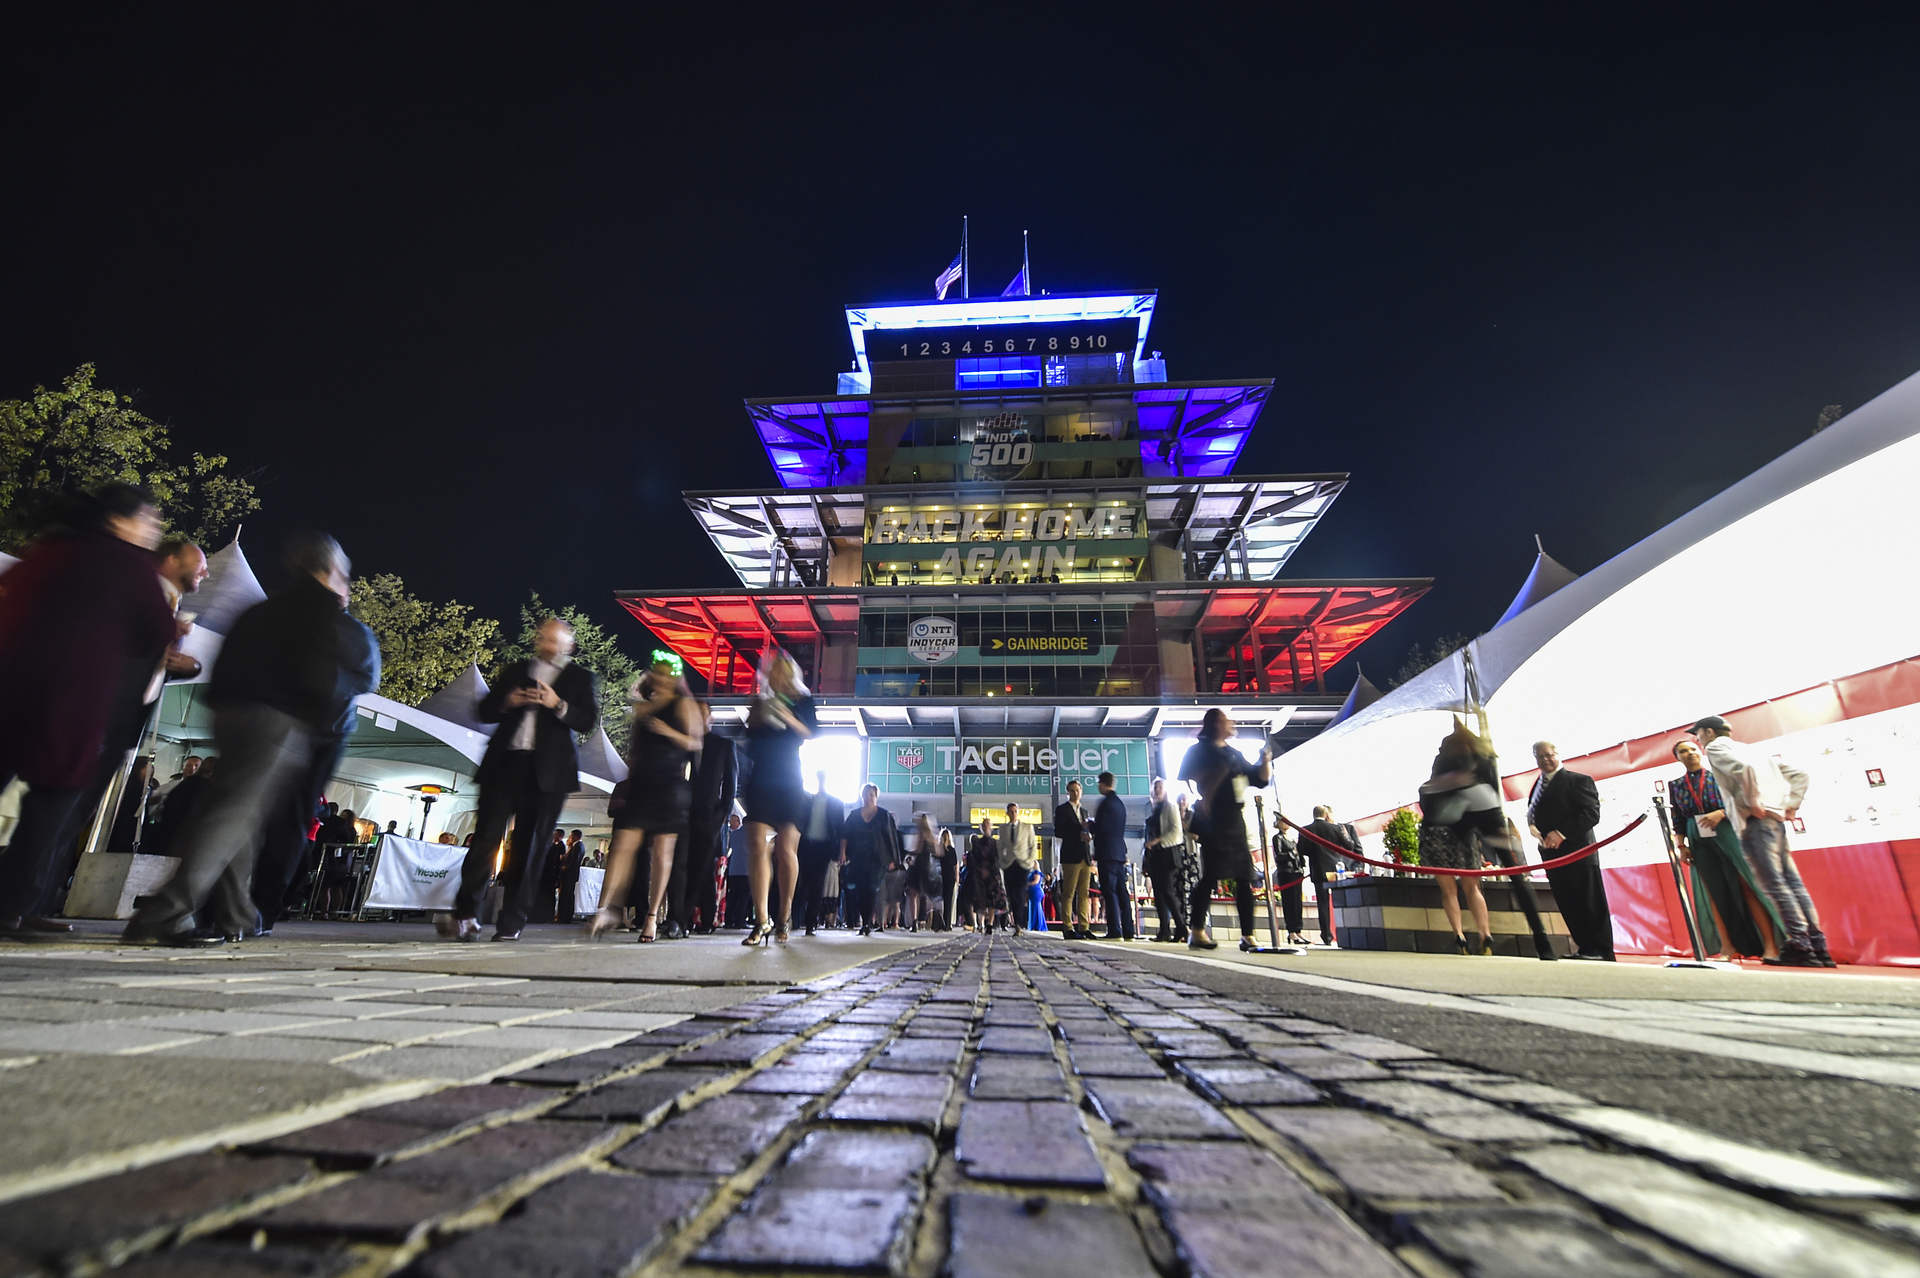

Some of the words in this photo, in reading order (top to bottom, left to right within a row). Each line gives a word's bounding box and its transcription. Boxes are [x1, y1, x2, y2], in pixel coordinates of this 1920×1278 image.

[900, 344, 908, 356] 1
[920, 343, 930, 355] 2
[942, 342, 950, 354] 3
[962, 341, 972, 354] 4
[984, 340, 994, 352] 5
[1006, 339, 1014, 352] 6
[1027, 338, 1036, 350] 7
[1048, 338, 1058, 350] 8
[1070, 336, 1080, 349] 9
[1086, 335, 1107, 348] 10
[985, 432, 1018, 444] INDY
[971, 443, 1033, 466] 500
[870, 511, 994, 544] BACK
[1003, 507, 1136, 542] HOME
[934, 545, 1076, 580] AGAIN
[931, 626, 952, 634] NTT
[910, 638, 956, 646] INDYCAR
[1008, 637, 1088, 650] GAINBRIDGE
[898, 756, 924, 768] HEUER
[911, 776, 994, 786] OFFICIAL
[1005, 776, 1099, 786] TIMEPIC
[414, 866, 448, 878] Messer
